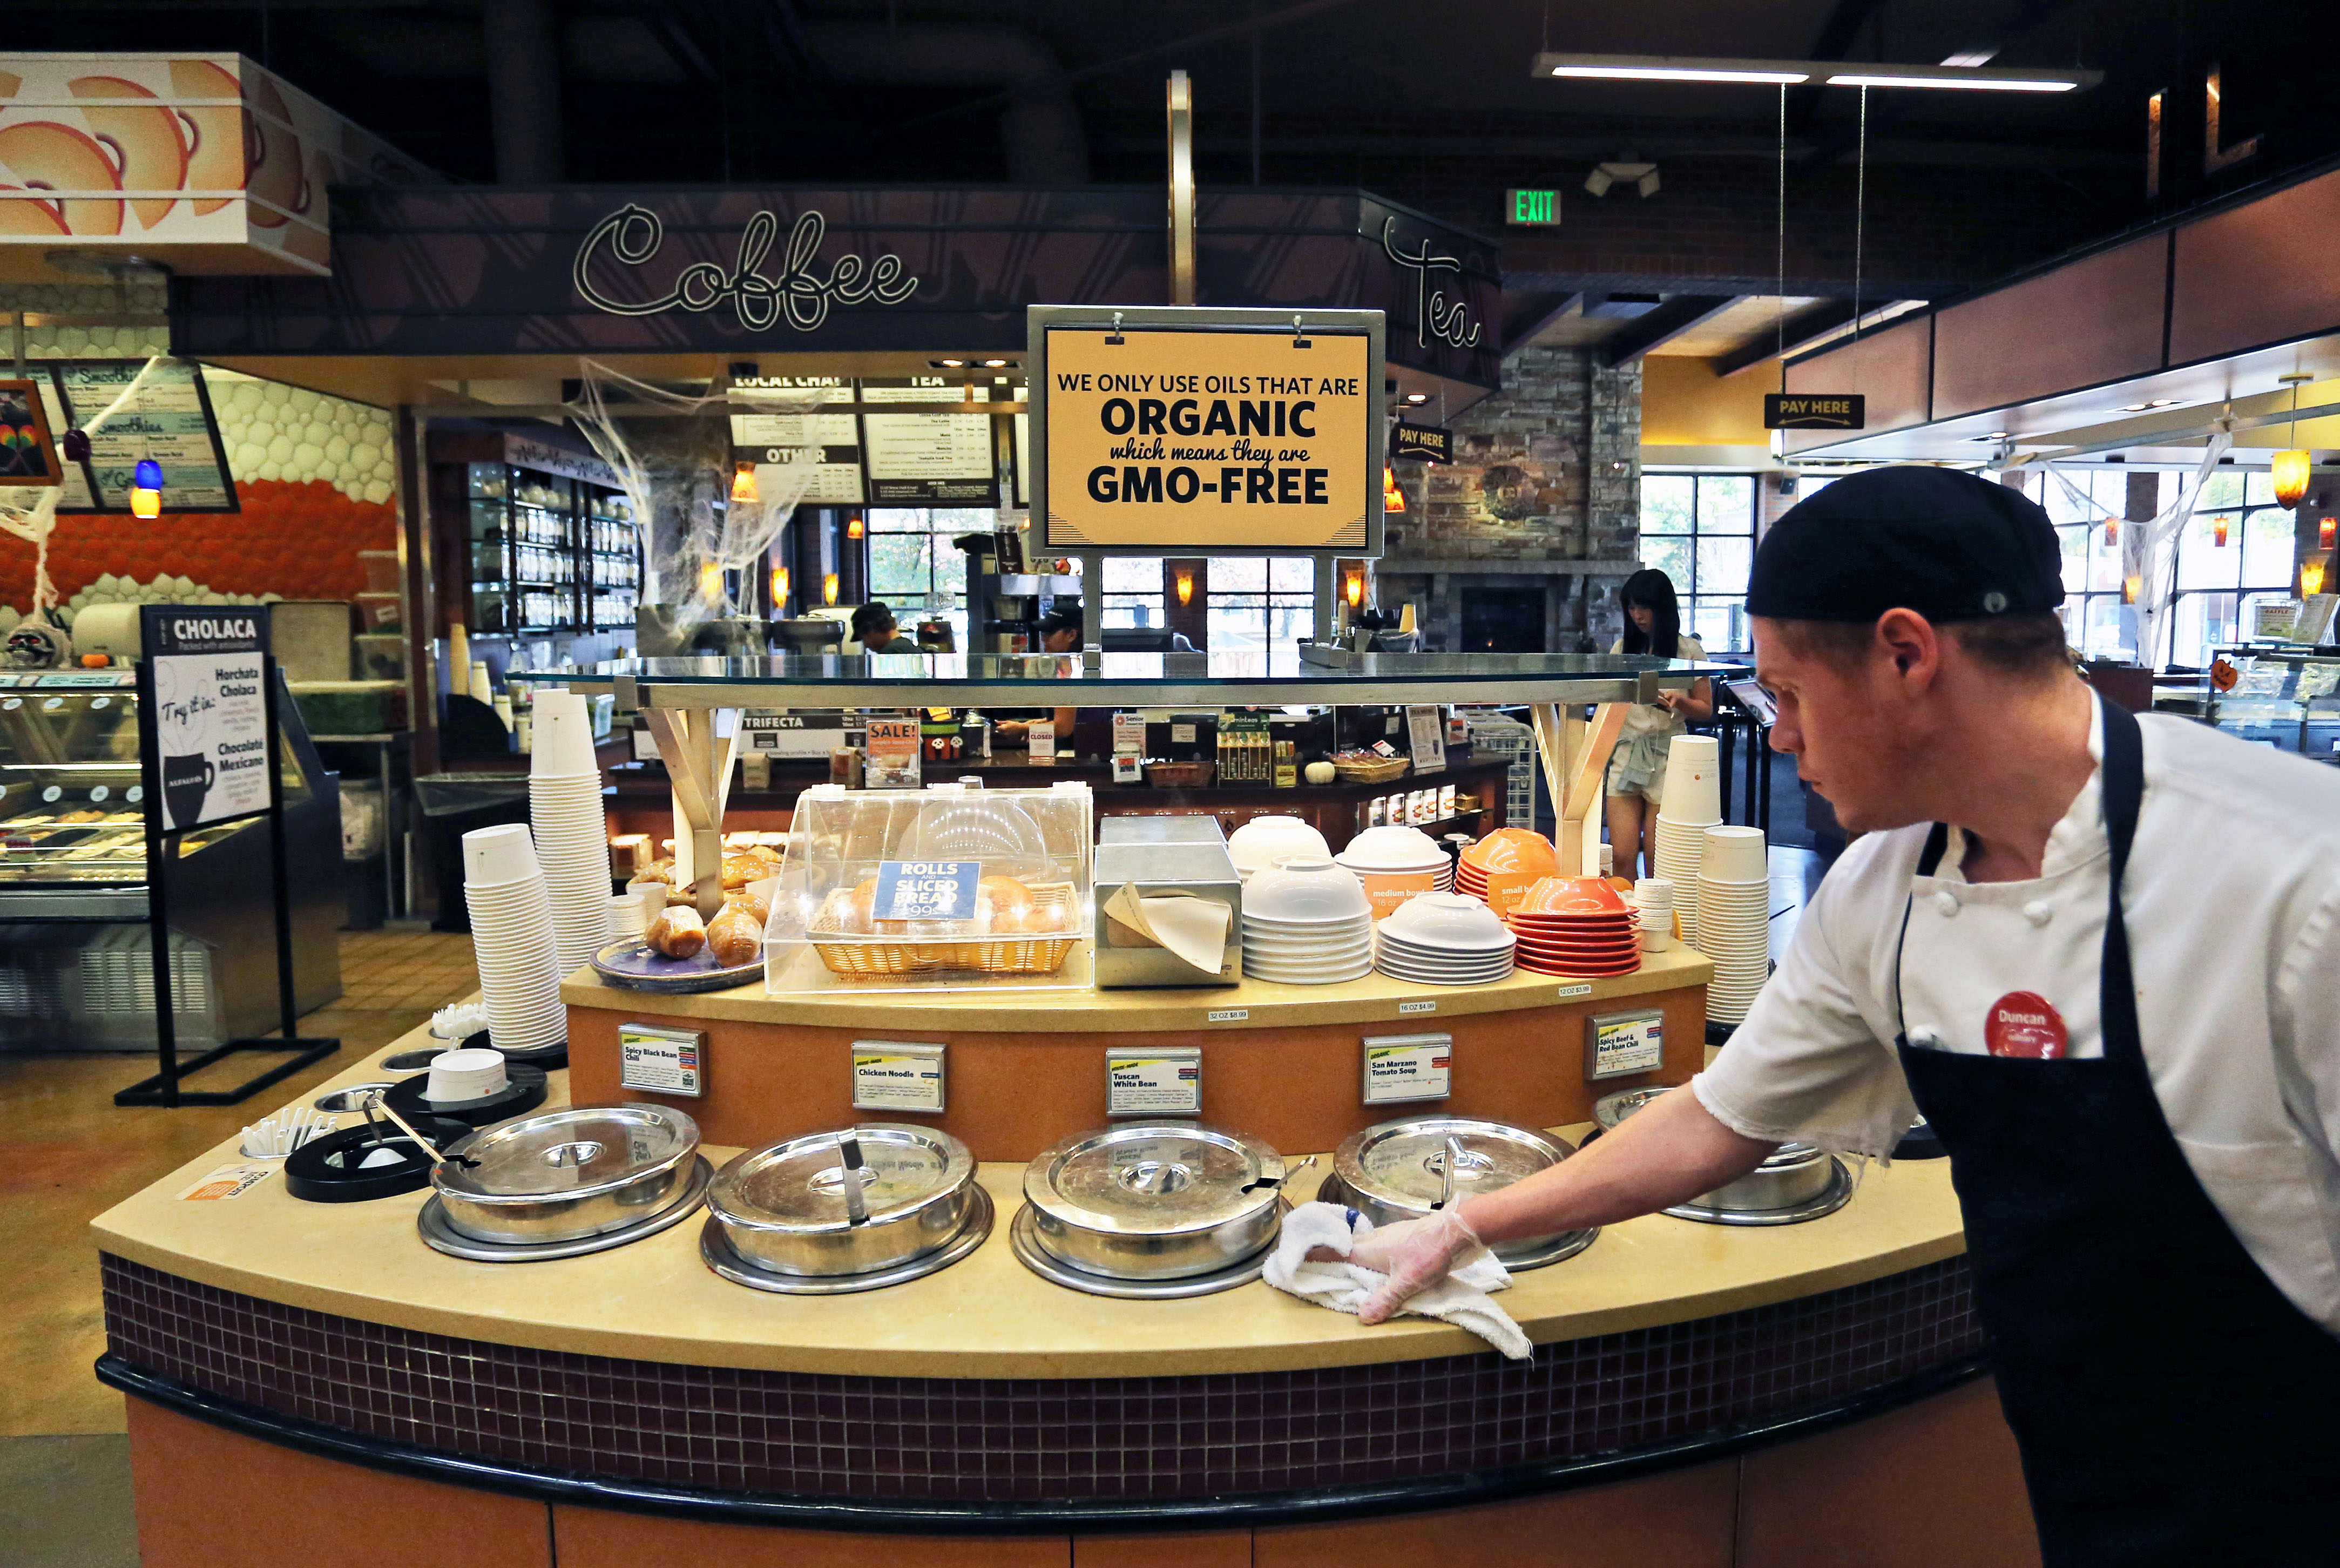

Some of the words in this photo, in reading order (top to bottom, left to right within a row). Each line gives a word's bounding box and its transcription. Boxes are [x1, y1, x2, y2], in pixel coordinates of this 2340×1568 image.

[1516, 191, 1554, 221] EXIT
[574, 203, 917, 332] Coffee
[1384, 216, 1480, 348] Tea
[1057, 374, 1091, 391] WE
[1098, 374, 1153, 393] ONLY
[1160, 375, 1199, 393] USE
[1205, 376, 1250, 394] OILS
[1256, 377, 1313, 395] THAT
[1318, 378, 1358, 396] ARE
[1780, 401, 1809, 413] PAY
[1811, 401, 1850, 414] HERE
[1100, 398, 1316, 437] ORGANIC
[1400, 428, 1418, 444] PAY
[1420, 431, 1444, 448] HERE
[766, 449, 826, 463] OTHR
[1111, 437, 1166, 461] which
[1171, 446, 1228, 461] means
[1231, 438, 1273, 470] they
[1279, 447, 1310, 462] are
[1087, 466, 1328, 504] GMO-FREE
[174, 619, 256, 640] CHOLACA
[215, 667, 259, 681] Horchata
[220, 685, 256, 697] Cholaca
[162, 702, 188, 725] Try
[745, 717, 804, 727] TRIFECTA
[870, 725, 915, 738] SALE!
[218, 738, 263, 755] Chocolate
[901, 863, 958, 875] ROLLS
[895, 880, 958, 891] SLICED
[894, 892, 957, 904] BREAD
[1999, 1009, 2046, 1025] Duncan
[626, 1046, 641, 1055] Spicy
